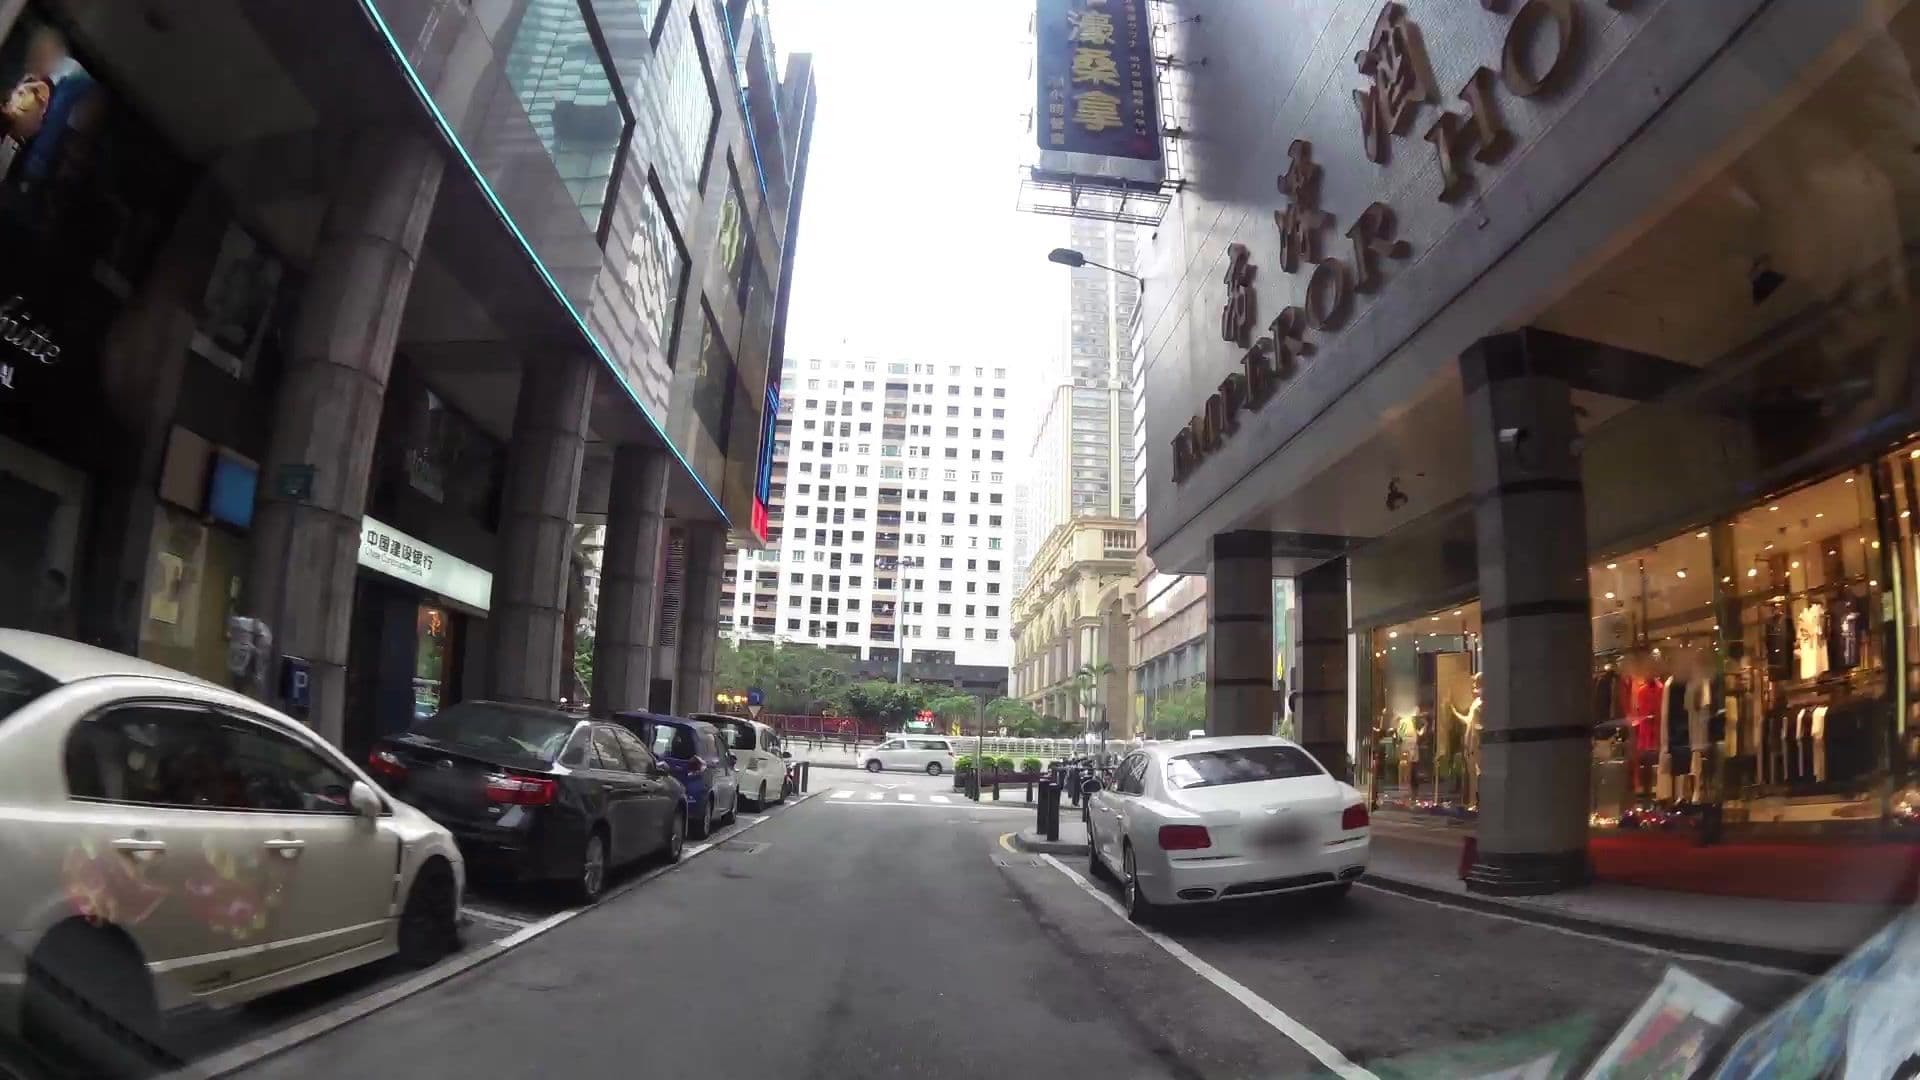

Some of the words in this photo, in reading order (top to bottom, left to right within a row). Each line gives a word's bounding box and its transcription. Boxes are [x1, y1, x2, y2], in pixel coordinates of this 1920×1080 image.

[1067, 0, 1123, 132] 濠桑拿
[1171, 201, 1413, 484] EMPEROR
[367, 530, 434, 570] 中国建设银行
[294, 670, 309, 699] P
